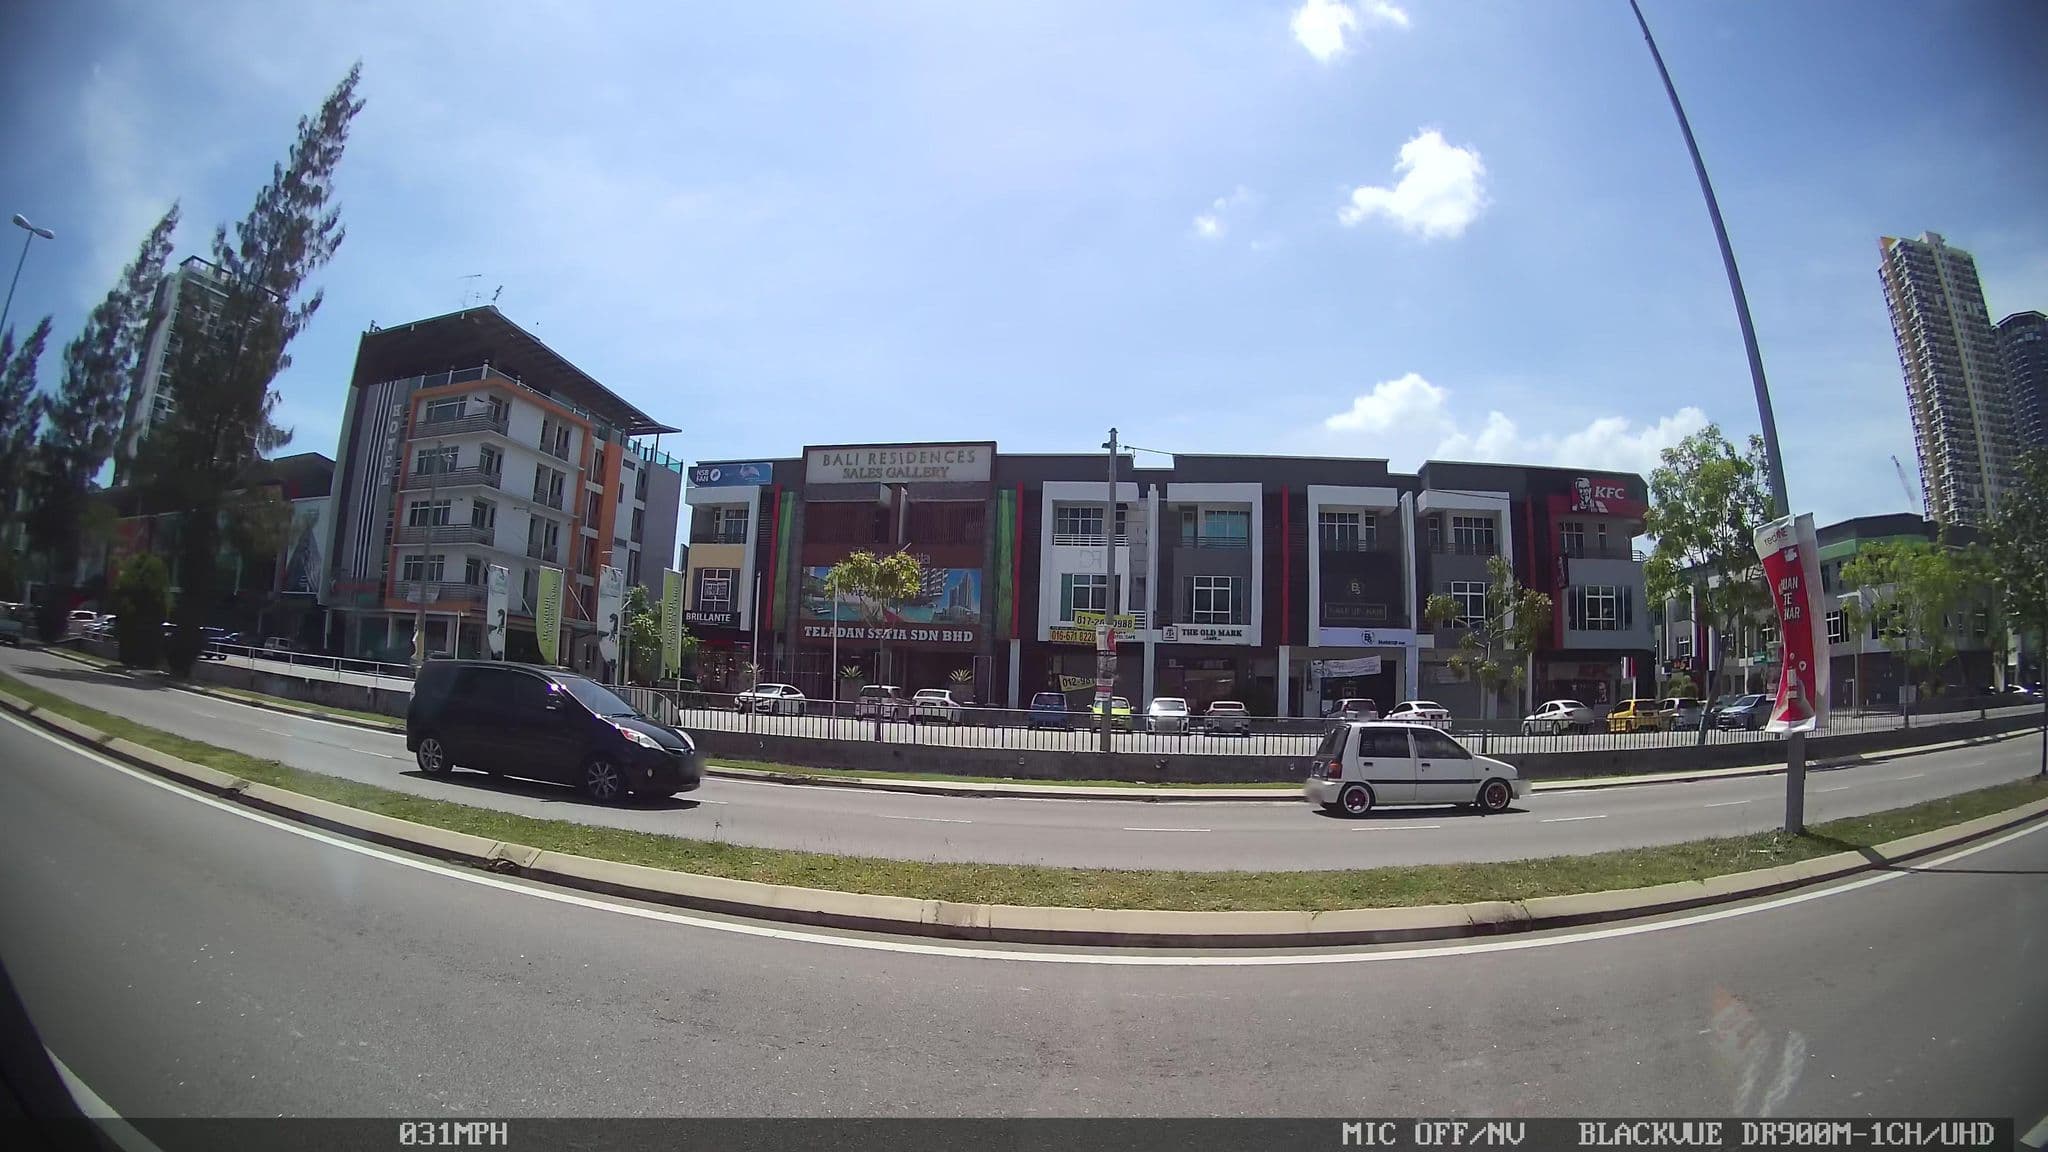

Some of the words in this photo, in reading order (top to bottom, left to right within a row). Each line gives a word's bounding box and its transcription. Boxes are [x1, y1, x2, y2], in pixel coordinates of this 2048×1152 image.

[381, 404, 402, 486] HOTEL
[823, 452, 860, 467] BALI
[868, 450, 976, 465] RESIDENCES
[843, 467, 883, 480] SALES
[885, 466, 950, 479] GALLERY
[1594, 486, 1625, 499] KFC
[686, 612, 731, 622] BRILLANTE
[804, 626, 864, 639] TELADAN
[910, 629, 939, 641] SDN
[942, 630, 974, 642] BHD
[1181, 628, 1199, 636] THE
[1218, 629, 1243, 637] MARK
